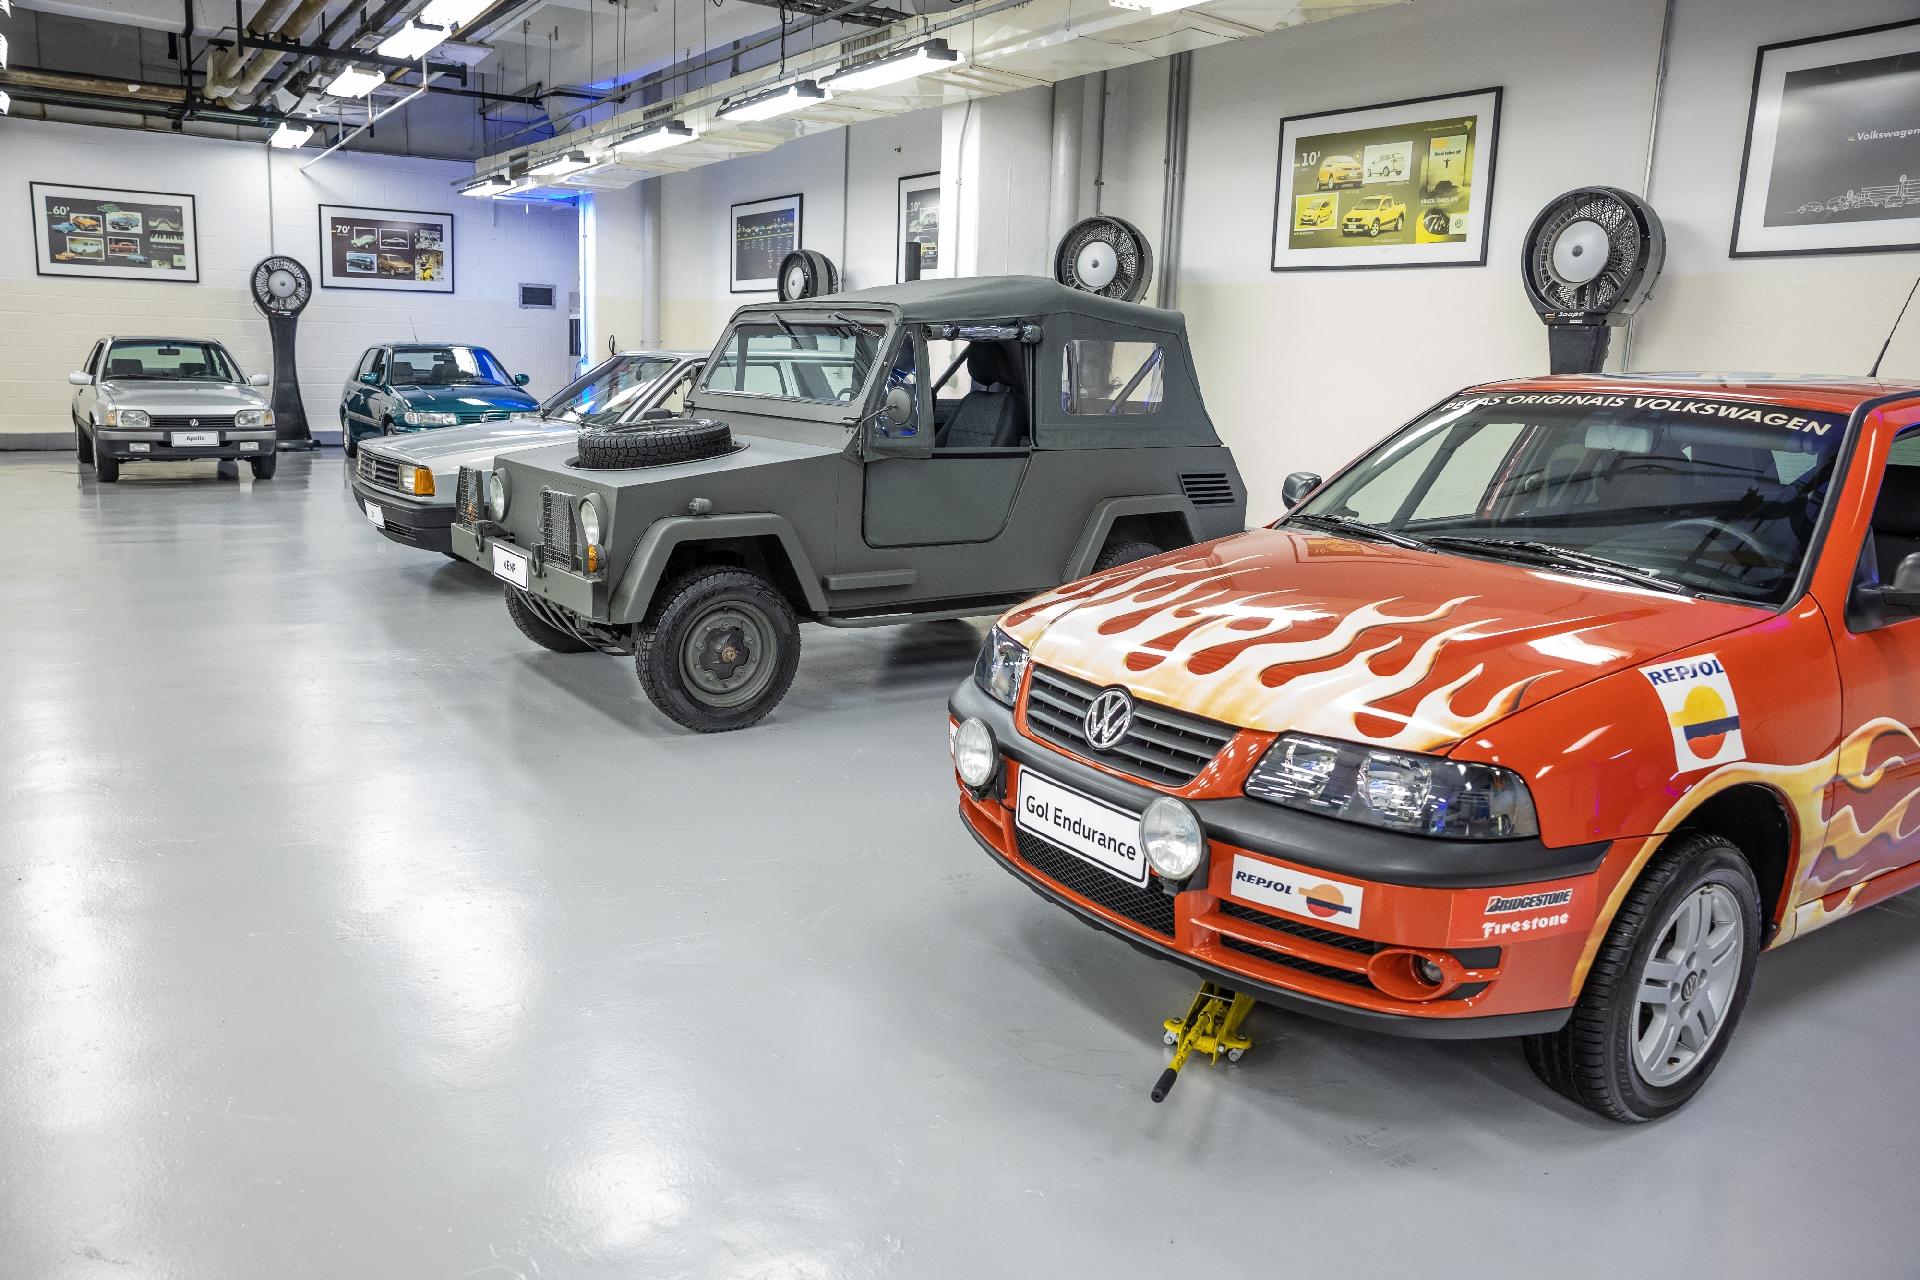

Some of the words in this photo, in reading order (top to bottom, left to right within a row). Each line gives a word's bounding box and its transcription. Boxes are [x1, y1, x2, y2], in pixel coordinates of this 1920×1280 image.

[1857, 128, 1920, 141] Volkswagen
[1507, 395, 1630, 407] ORIGINAIS
[1634, 397, 1832, 436] VOLKSWAGEN
[1647, 659, 1725, 686] REPSOL
[1026, 795, 1049, 822] Gol
[1053, 806, 1136, 861] Endurance
[1235, 870, 1293, 895] REPSOL
[1485, 889, 1572, 914] BRIDGESTONE
[1482, 912, 1569, 939] Firestone
